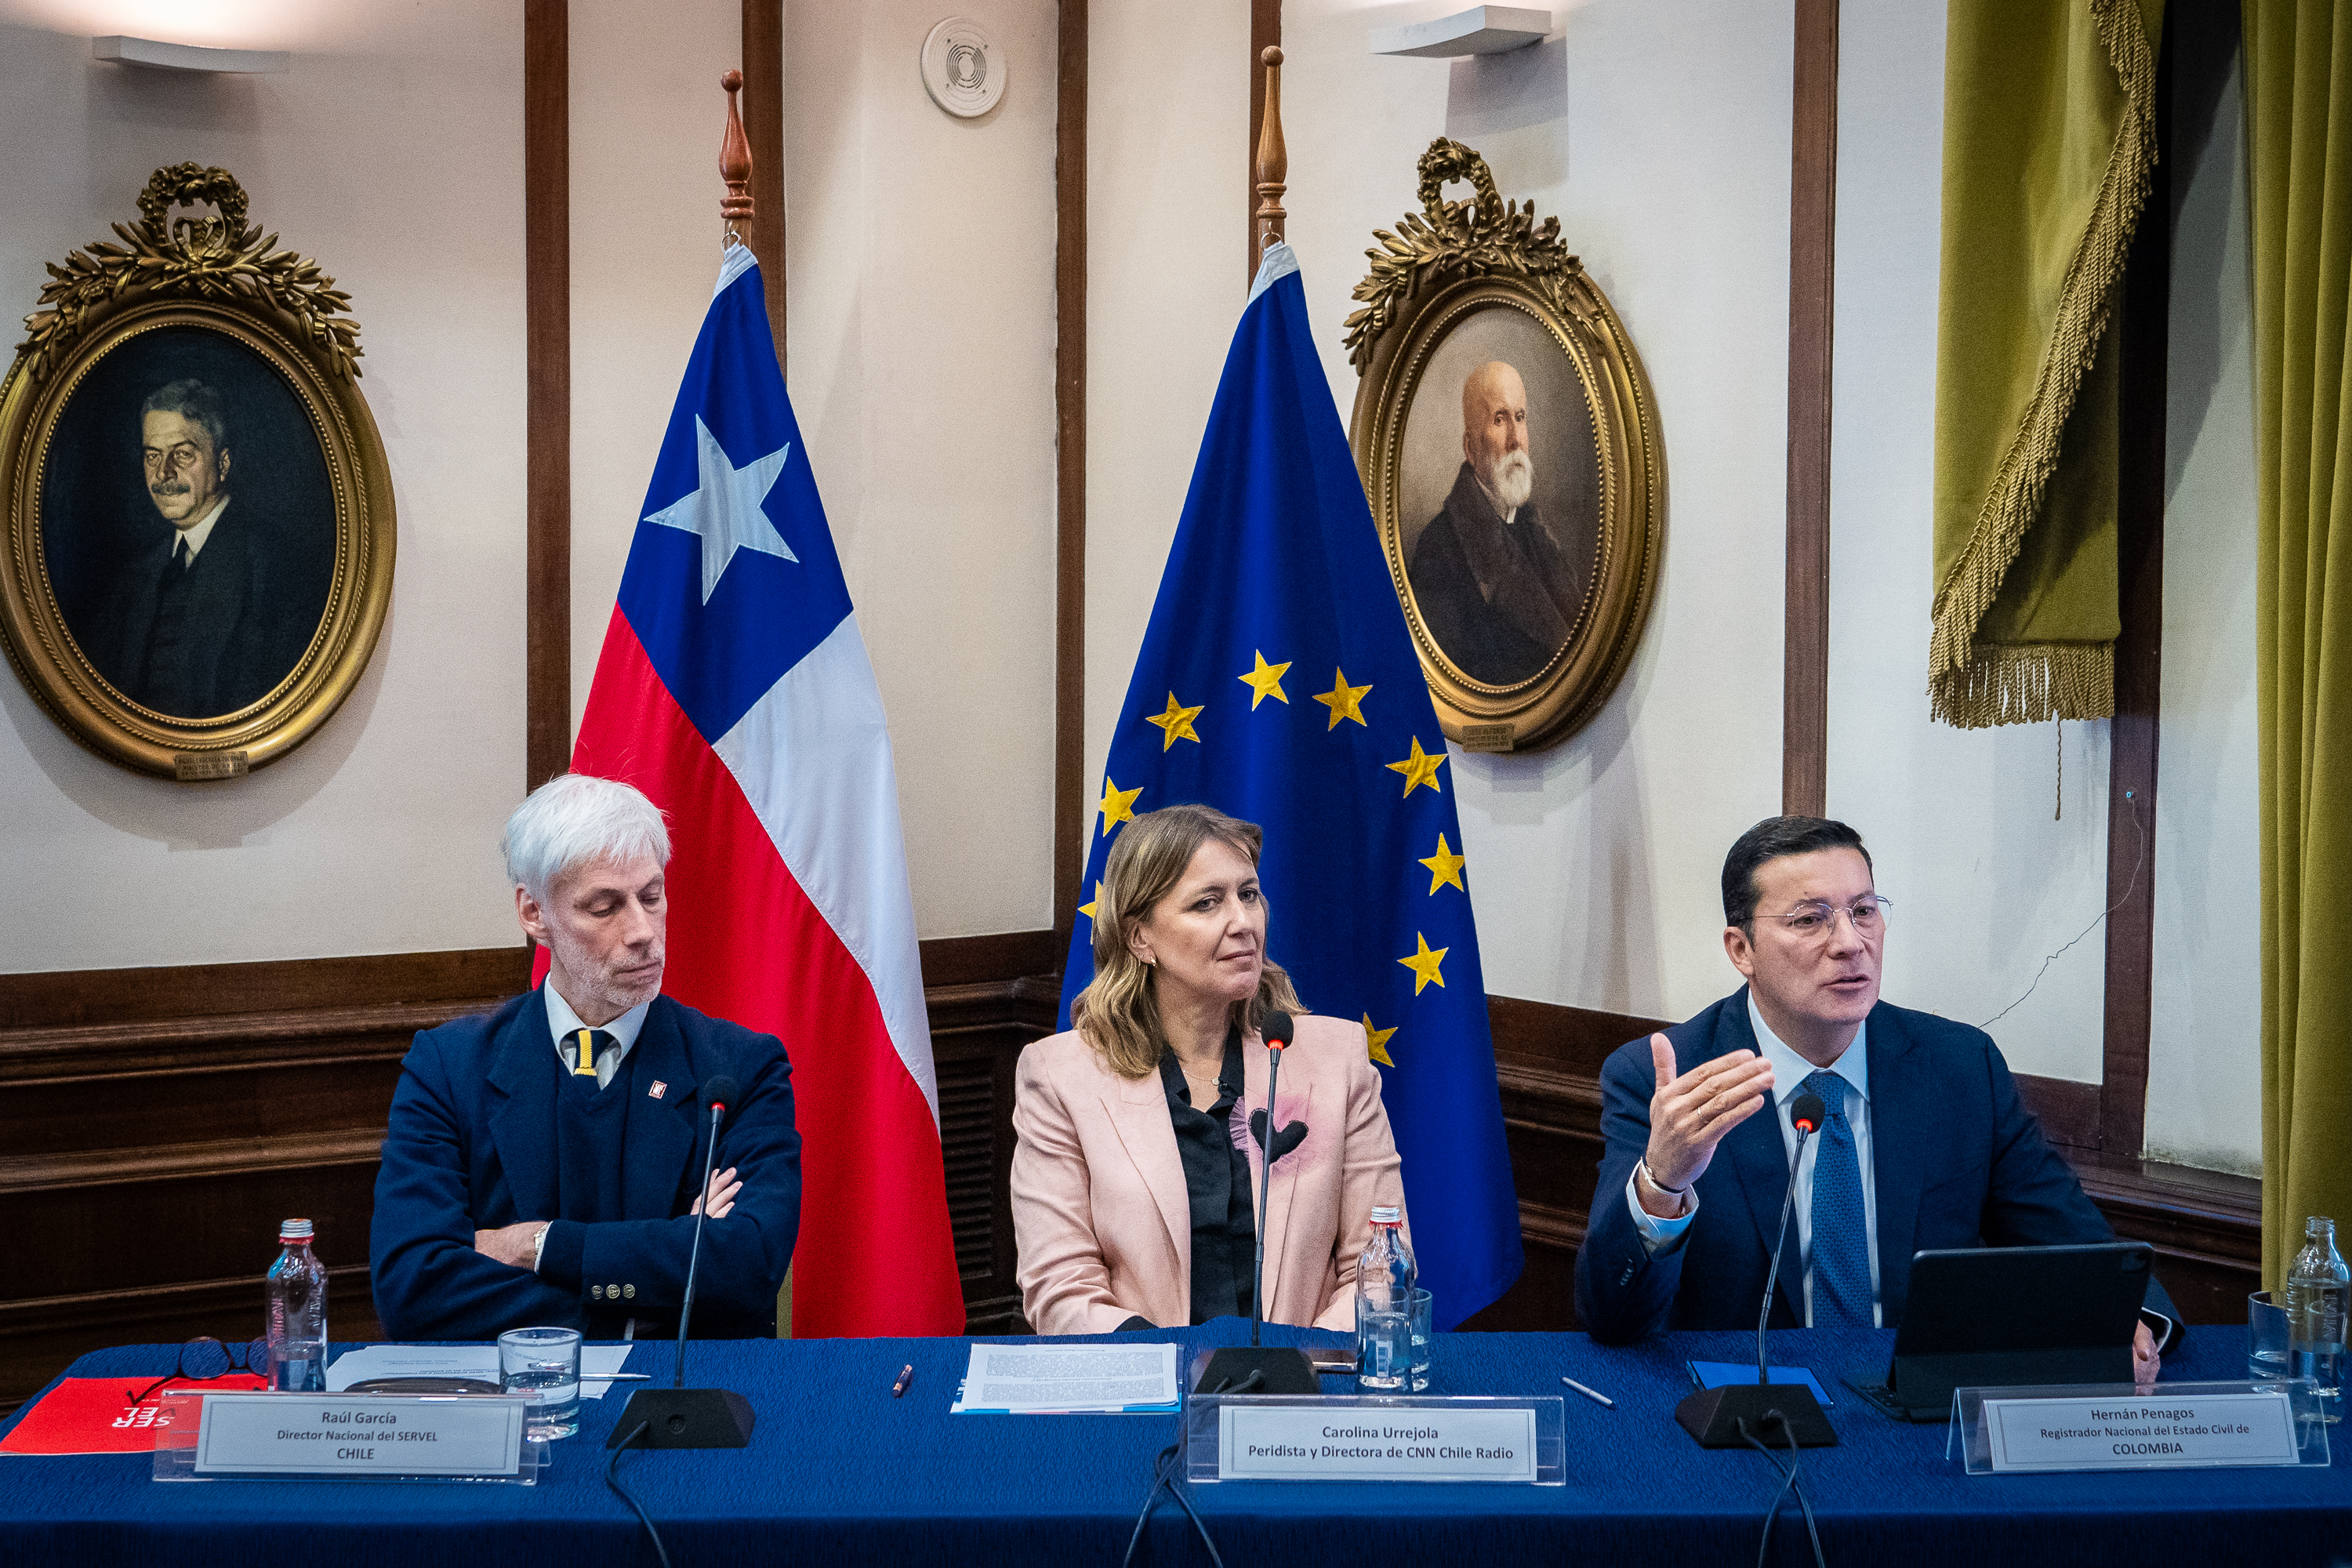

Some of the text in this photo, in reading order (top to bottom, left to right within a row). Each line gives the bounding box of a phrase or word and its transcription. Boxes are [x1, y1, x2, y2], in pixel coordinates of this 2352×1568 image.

[321, 1411, 397, 1425] Raúl García
[2090, 1408, 2195, 1421] Hernán Penagos
[111, 1416, 175, 1428] SER
[277, 1429, 437, 1442] Director Nacional del SERVEL
[1322, 1425, 1439, 1442] Carolina Urrejola
[2040, 1424, 2250, 1440] Registrador Nacional del Estado Civil de
[336, 1447, 375, 1460] CHILE
[1248, 1444, 1514, 1460] Peridista y Directora de CNN Chile Radio
[2112, 1442, 2183, 1456] COLOMBIA
